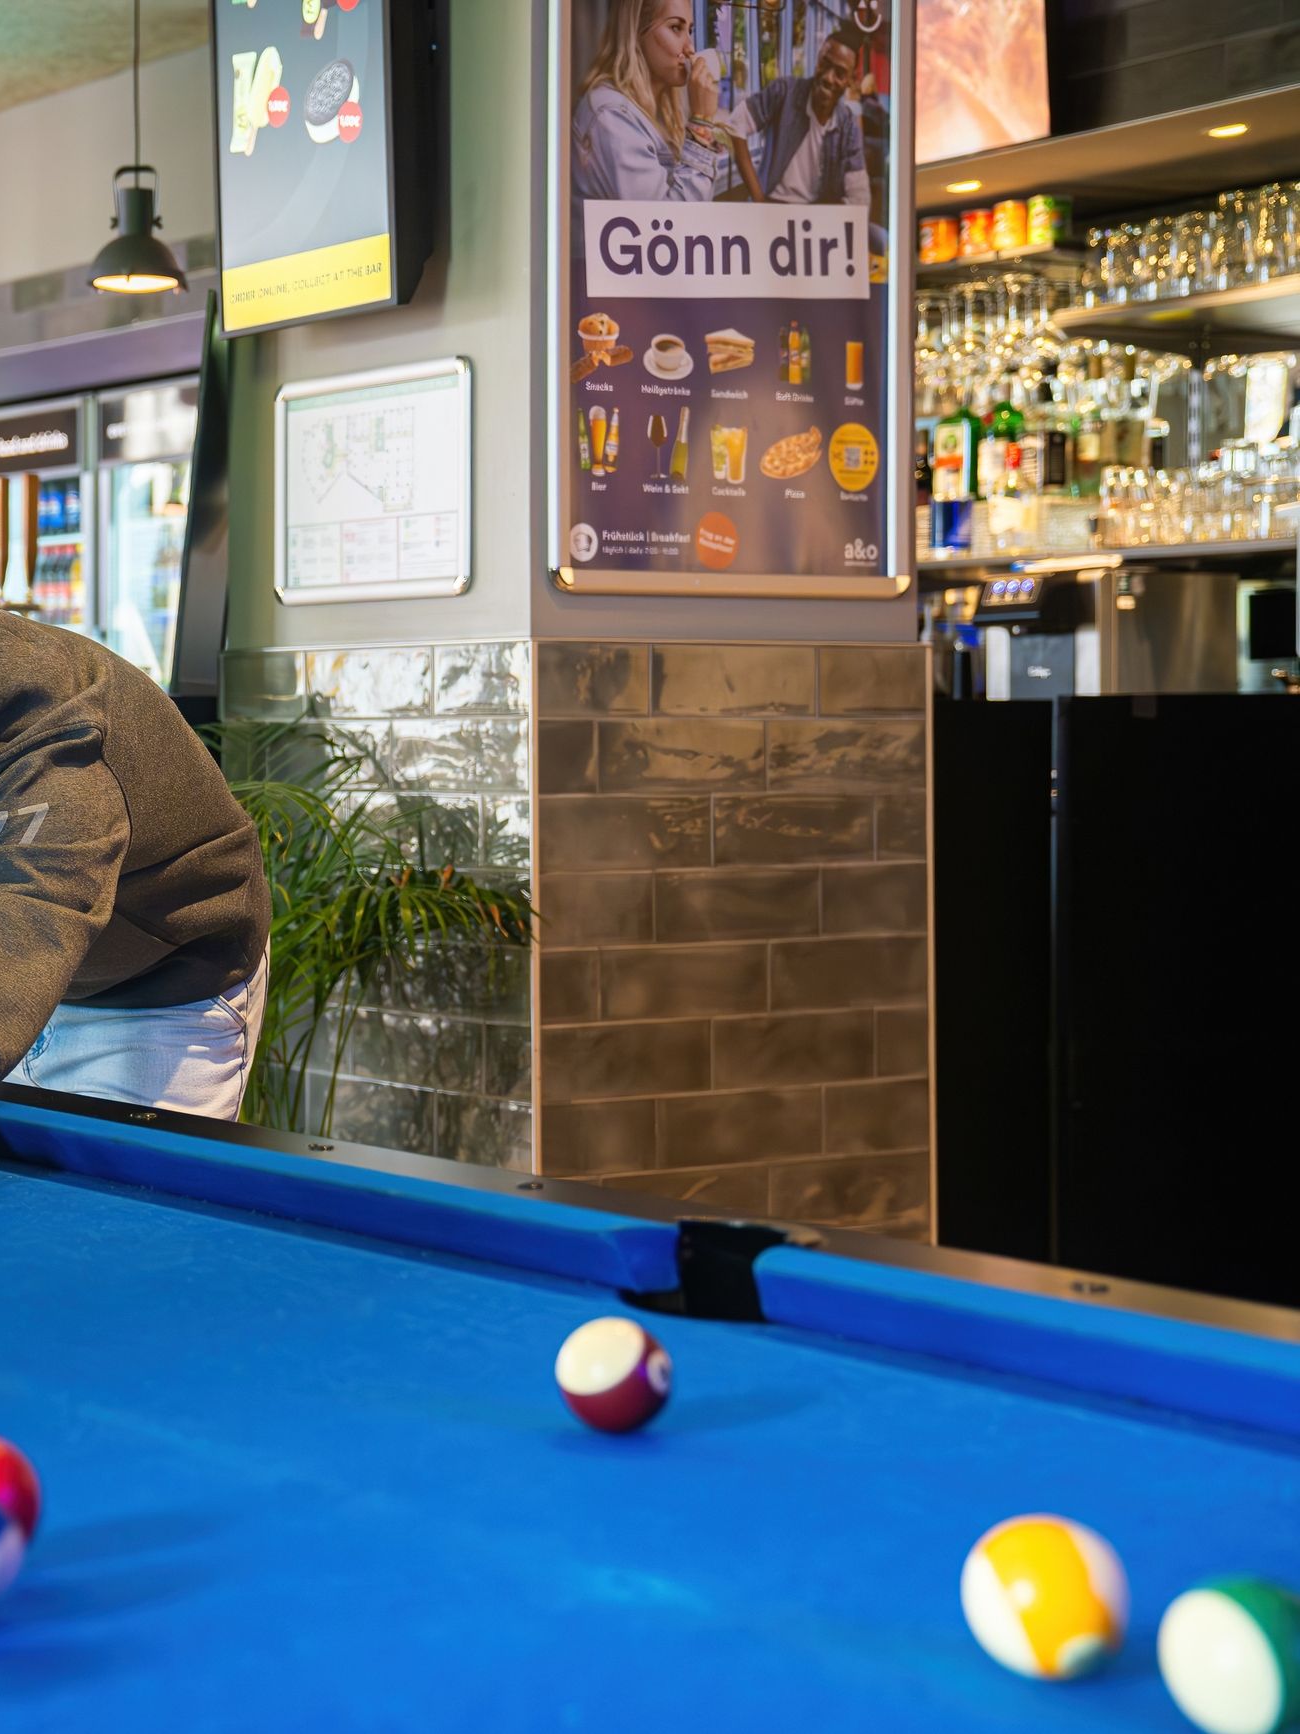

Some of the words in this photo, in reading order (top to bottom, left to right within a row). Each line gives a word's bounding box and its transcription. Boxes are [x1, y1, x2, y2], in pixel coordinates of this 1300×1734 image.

[599, 216, 751, 276] Gönn
[768, 219, 856, 277] dir!
[333, 270, 345, 281] AT
[347, 266, 363, 278] THE
[365, 262, 382, 275] BAR
[585, 381, 614, 392] Snacks
[591, 482, 607, 491] Bier
[643, 483, 663, 493] Wein
[844, 538, 878, 560] a&o
